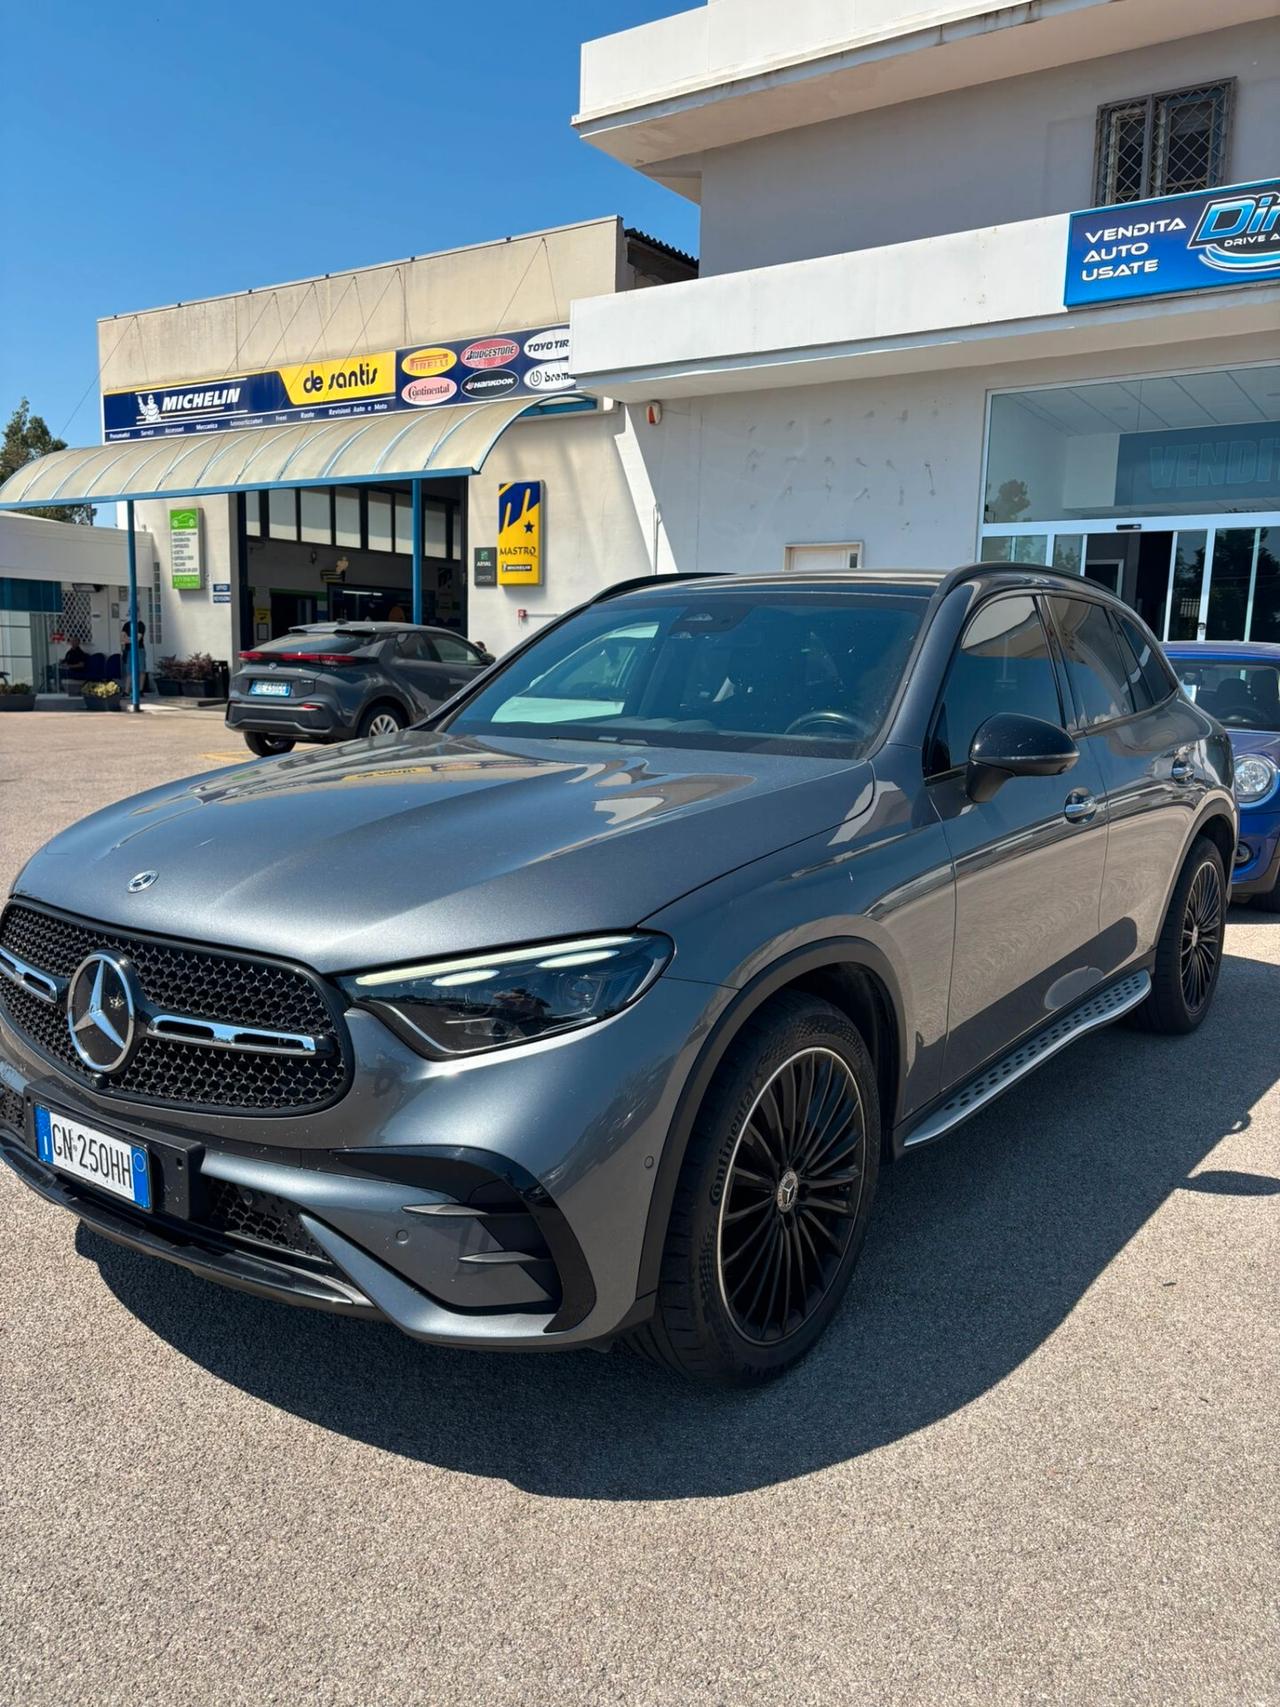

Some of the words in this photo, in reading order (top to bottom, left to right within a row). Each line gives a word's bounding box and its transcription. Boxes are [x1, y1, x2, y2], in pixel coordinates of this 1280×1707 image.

[1085, 217, 1187, 244] VENDITA
[1224, 234, 1266, 248] DRIVE
[1083, 242, 1150, 263] AUTO
[1081, 259, 1160, 281] USATE
[466, 345, 516, 361] BRIDGESTONE
[526, 341, 553, 353] TOYO
[409, 353, 449, 371] PIRELLI
[303, 369, 323, 394] de
[328, 363, 377, 390] santis
[162, 388, 240, 411] MICHELIN
[408, 383, 450, 400] Continental
[500, 546, 537, 556] MASTRO
